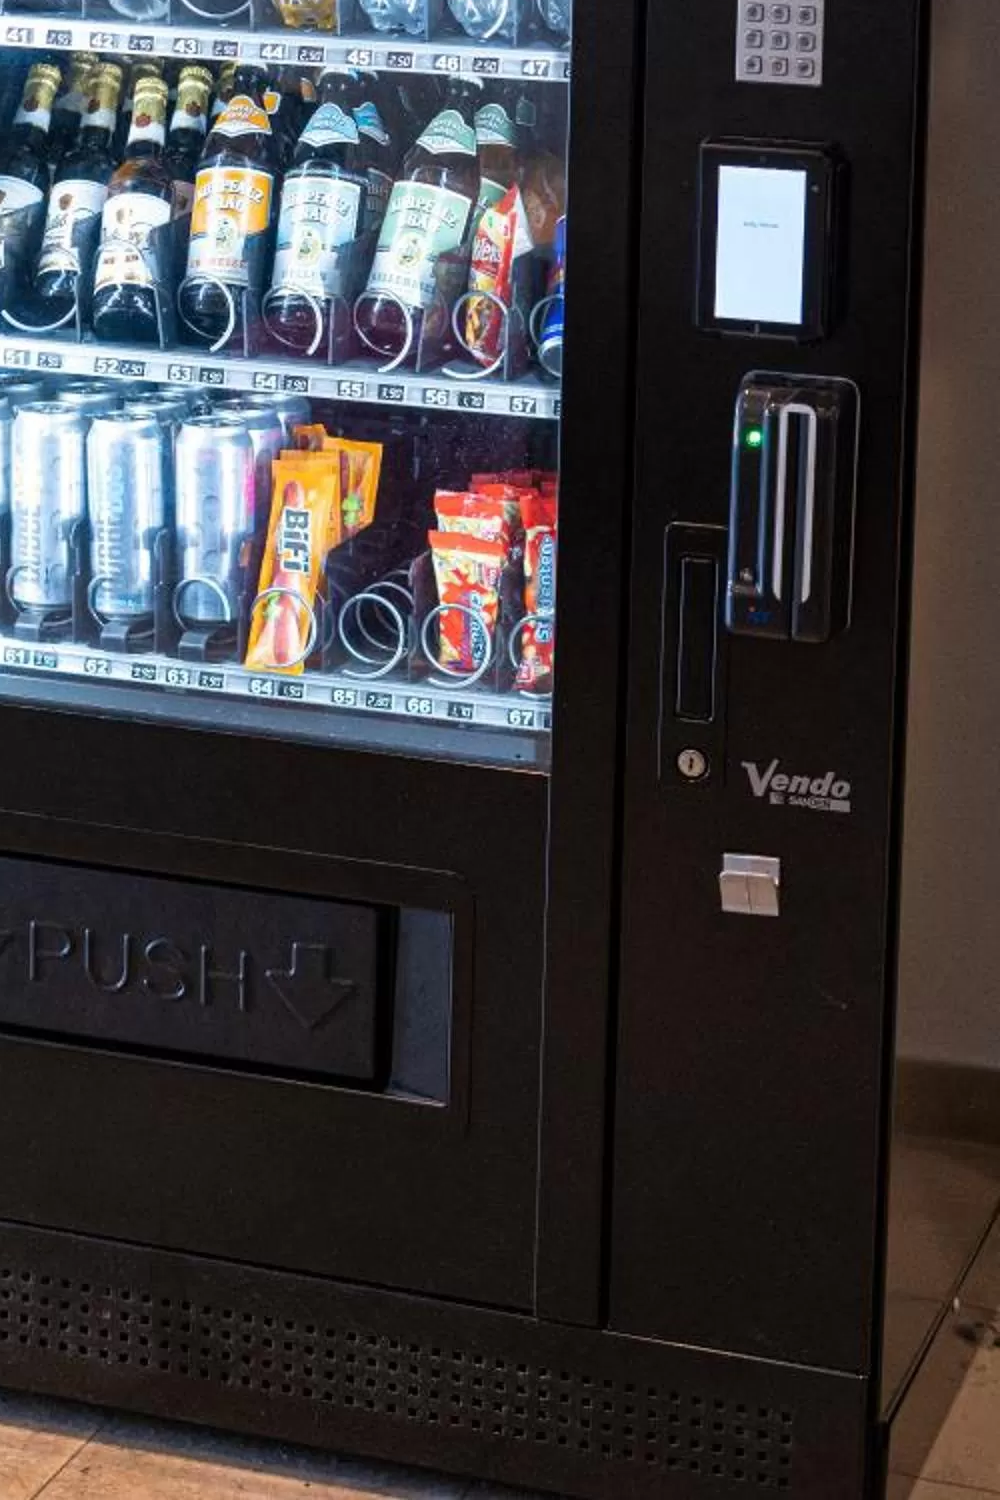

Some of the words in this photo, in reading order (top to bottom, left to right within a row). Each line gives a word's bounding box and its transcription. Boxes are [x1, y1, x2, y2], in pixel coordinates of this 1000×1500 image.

[5, 26, 29, 43] 41
[90, 32, 114, 48] 42
[174, 38, 198, 54] 43
[260, 43, 284, 59] 44
[347, 50, 371, 66] 45
[434, 55, 459, 71] 46
[522, 59, 547, 76] 47
[97, 357, 120, 374] 52
[168, 364, 192, 381] 53
[254, 373, 278, 389] 54
[339, 381, 363, 397] 55
[424, 388, 448, 404] 56
[511, 396, 535, 413] 57
[4, 648, 28, 665] 61
[85, 658, 110, 674] 62
[167, 668, 190, 684] 63
[249, 679, 272, 695] 64
[332, 689, 356, 706] 65
[406, 698, 431, 714] 66
[509, 709, 533, 726] 67
[740, 757, 851, 799] Vendo
[28, 919, 248, 1013] PUSH
